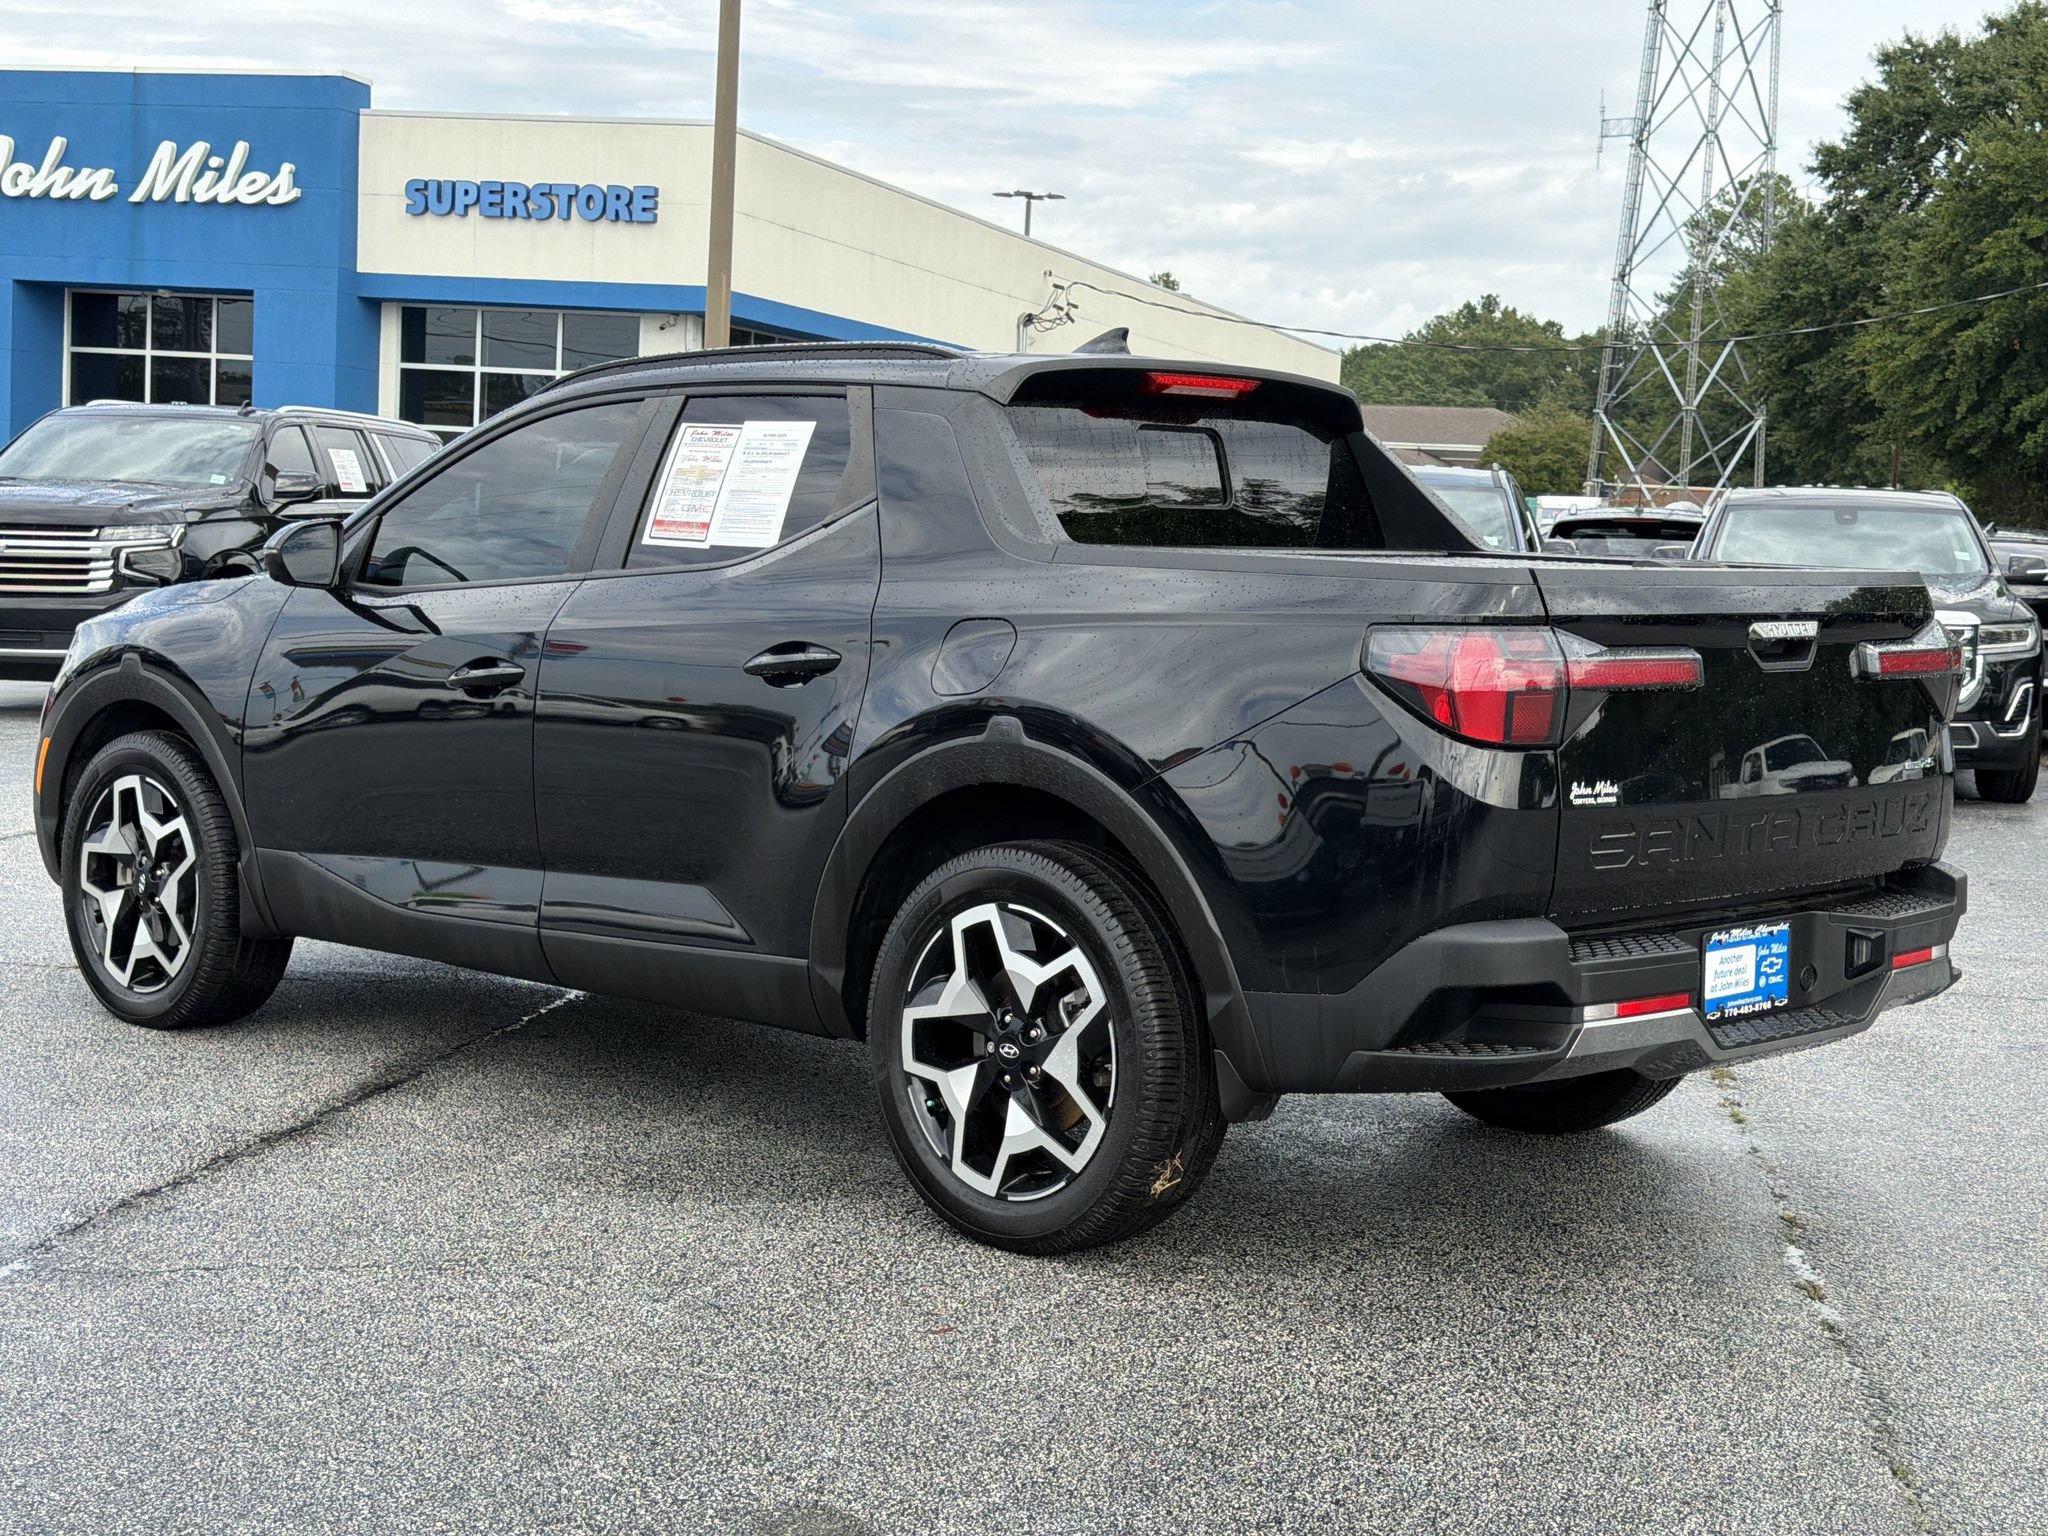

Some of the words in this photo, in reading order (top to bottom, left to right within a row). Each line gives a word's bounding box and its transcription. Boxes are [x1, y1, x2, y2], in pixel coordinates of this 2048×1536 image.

[128, 139, 301, 206] Miles
[405, 179, 659, 222] SUPERSTORE
[1570, 781, 1592, 800] John
[1593, 780, 1618, 796] Miles
[1590, 810, 1800, 870] SANTA
[1813, 792, 1931, 847] CRUZ
[1710, 932, 1728, 944] John
[1730, 928, 1752, 938] Miles
[1719, 954, 1743, 965] Another
[1757, 945, 1769, 960] John
[1771, 943, 1787, 953] Miles
[1714, 969, 1733, 981] future
[1734, 965, 1747, 975] deal
[1768, 975, 1784, 984] GMC
[1710, 985, 1717, 993] at
[1718, 981, 1733, 992] John
[1734, 977, 1749, 987] Miles
